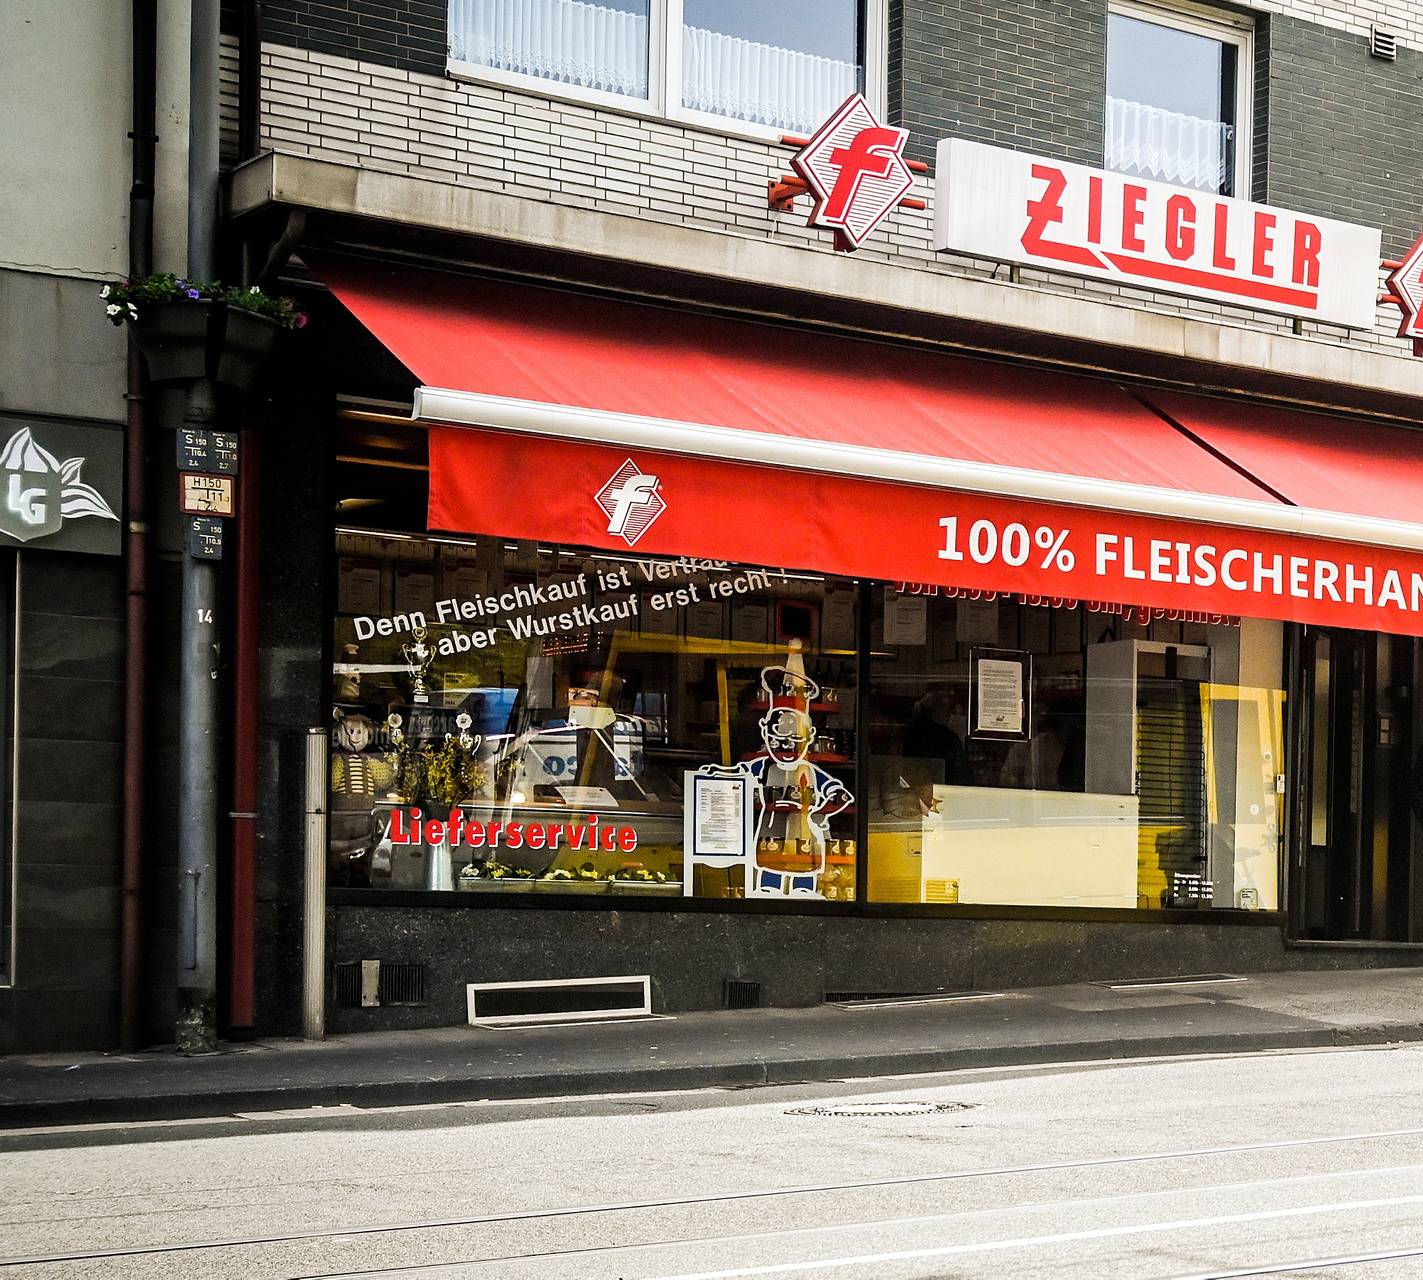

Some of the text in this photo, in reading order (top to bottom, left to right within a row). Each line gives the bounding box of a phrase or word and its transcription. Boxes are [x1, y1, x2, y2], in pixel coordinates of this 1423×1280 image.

[1020, 163, 1322, 290] ZIEGLER
[185, 434, 207, 446] S 150
[216, 437, 237, 449] S 150
[9, 473, 46, 523] LG
[193, 521, 201, 531] S
[937, 516, 1077, 573] 100%
[197, 608, 213, 624] 14
[353, 611, 427, 641] Denn
[435, 573, 588, 624] Fleischkauf
[597, 566, 632, 591] ist
[438, 627, 497, 656] aber
[506, 593, 639, 640] Wurstkauf
[650, 582, 701, 611] erst
[708, 568, 772, 599] recht
[390, 806, 639, 852] Lieferservice
